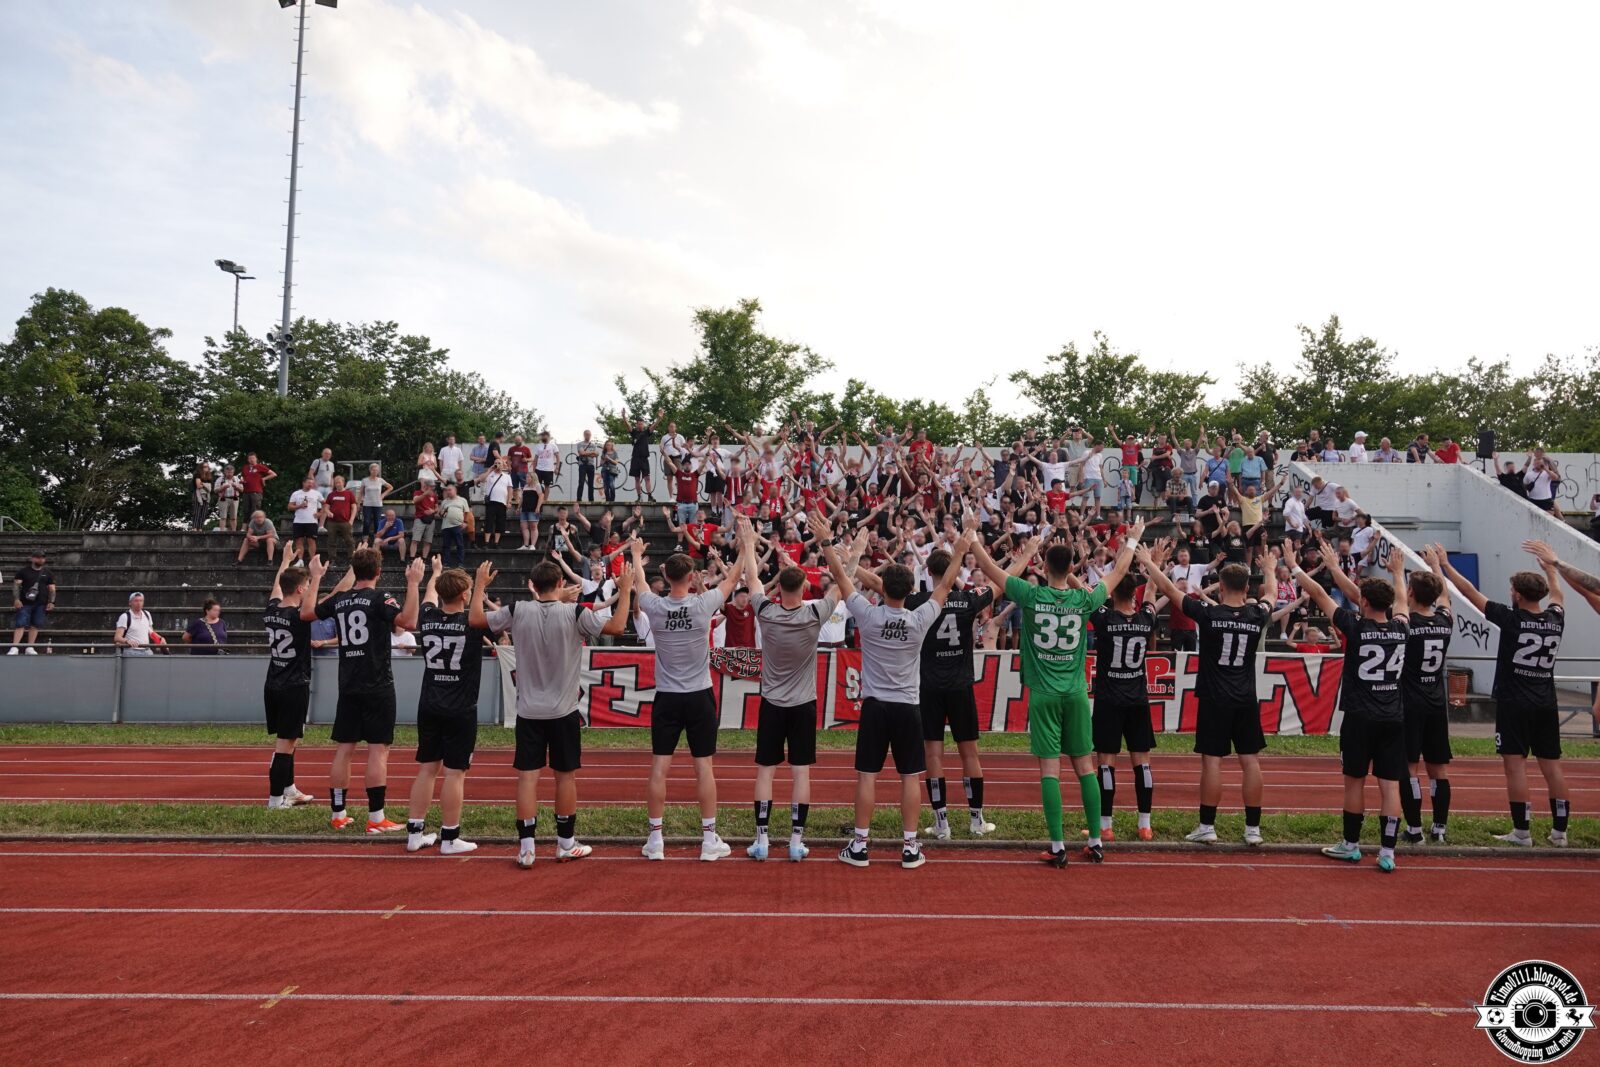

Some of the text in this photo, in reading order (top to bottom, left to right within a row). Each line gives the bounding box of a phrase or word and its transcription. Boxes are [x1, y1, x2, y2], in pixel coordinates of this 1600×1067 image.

[664, 619, 693, 631] 1905
[667, 606, 689, 620] seit
[884, 618, 907, 630] seit
[1035, 603, 1083, 615] REUTLINGEN
[265, 626, 297, 659] 22
[337, 610, 369, 646] 18
[421, 622, 466, 632] REUTLINGEN
[880, 628, 909, 642] 1905
[936, 613, 961, 646] 4
[1033, 612, 1082, 650] 33
[1107, 623, 1152, 632] REUTLINGEN
[1211, 620, 1261, 633] REUTLINGEN
[1360, 631, 1406, 640] REUTLNGEN
[422, 634, 466, 671] 27
[1110, 635, 1147, 669] 10
[1217, 632, 1249, 667] 11
[1358, 643, 1406, 681] 24
[1421, 639, 1444, 673] 5
[1512, 632, 1561, 669] 23
